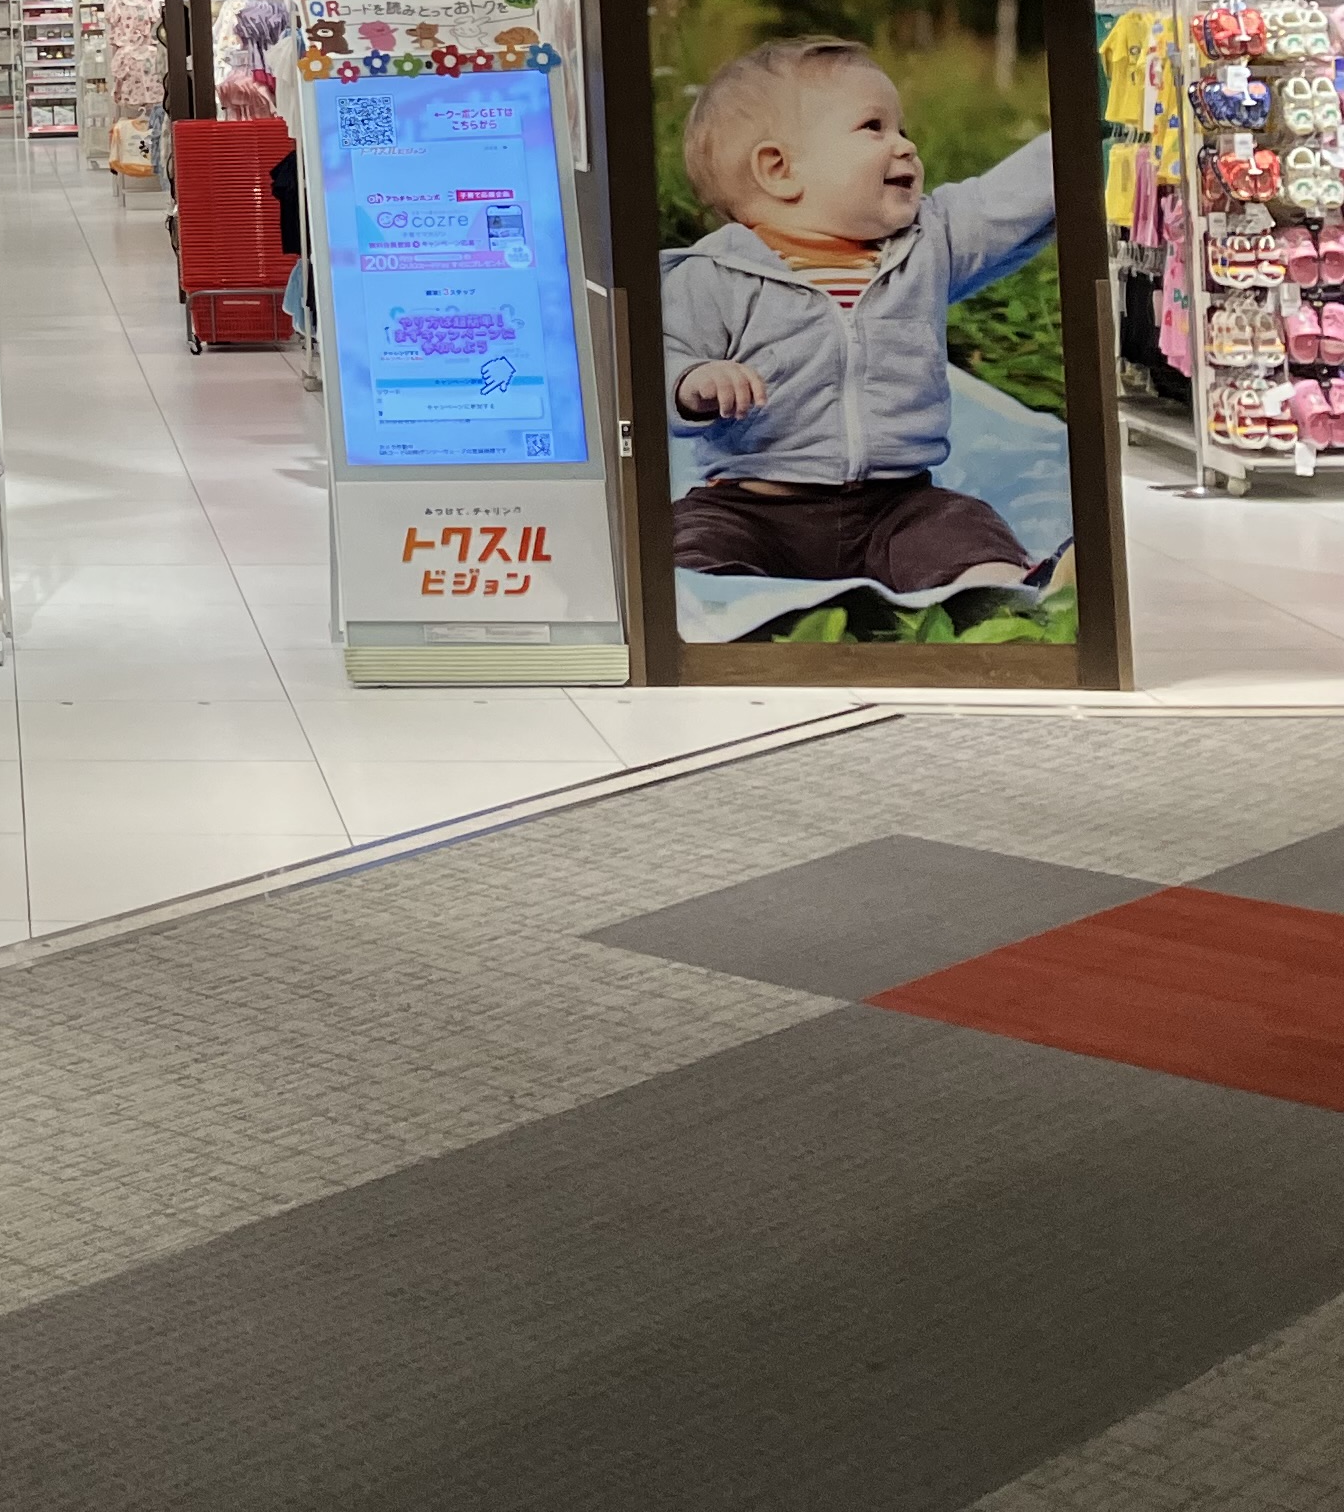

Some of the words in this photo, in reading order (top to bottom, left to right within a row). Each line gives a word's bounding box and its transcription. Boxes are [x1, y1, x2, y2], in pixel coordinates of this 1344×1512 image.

[309, 0, 510, 18] QRコードを読みとっておトクを
[452, 120, 498, 131] こちらから
[412, 214, 469, 228] cozre
[364, 255, 399, 271] 200
[402, 526, 552, 563] トクスル
[421, 568, 531, 596] ビジョン
